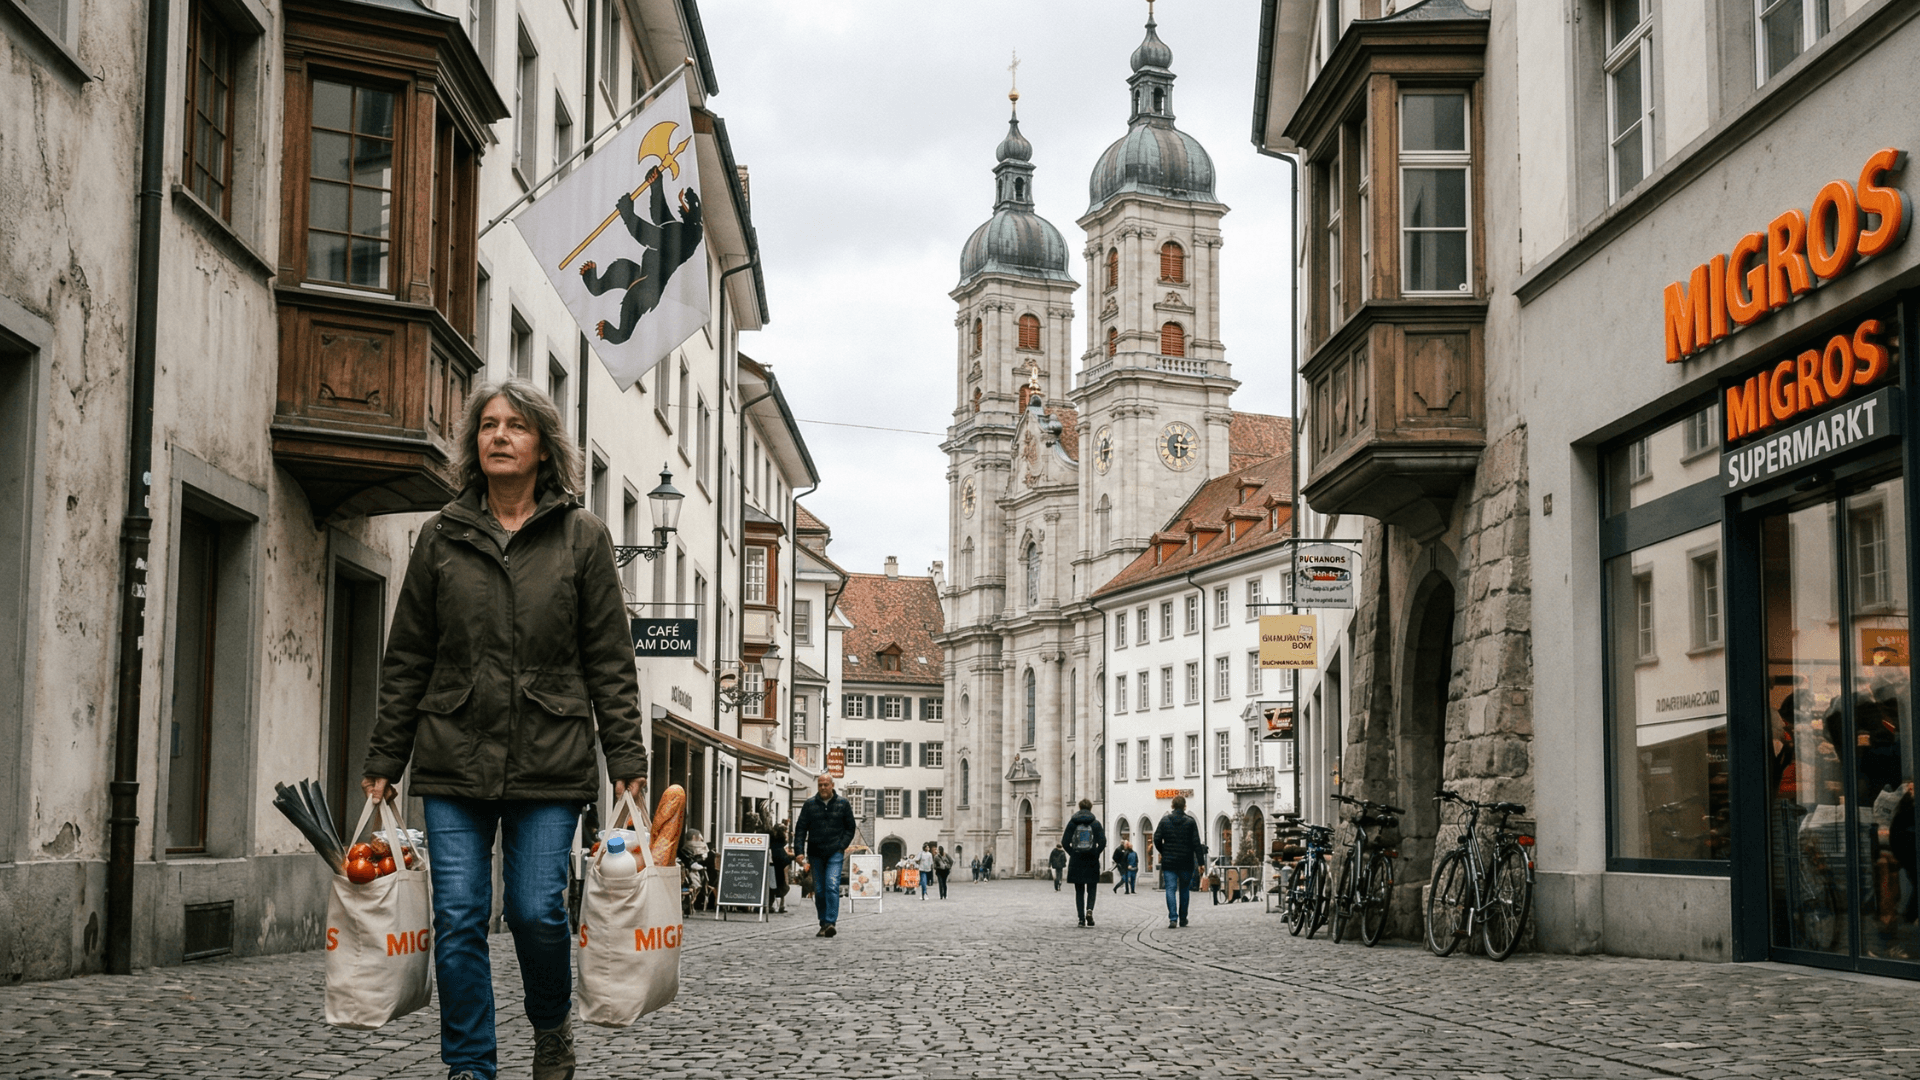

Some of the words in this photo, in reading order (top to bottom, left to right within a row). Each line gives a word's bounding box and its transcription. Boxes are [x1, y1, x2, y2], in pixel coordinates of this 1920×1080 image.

[1664, 147, 1903, 364] MIGROS
[1726, 319, 1887, 442] MIGROS
[1728, 398, 1877, 488] SUPERMARKT
[635, 639, 656, 650] AM
[660, 639, 691, 650] DOM
[647, 623, 679, 637] CAFÉ
